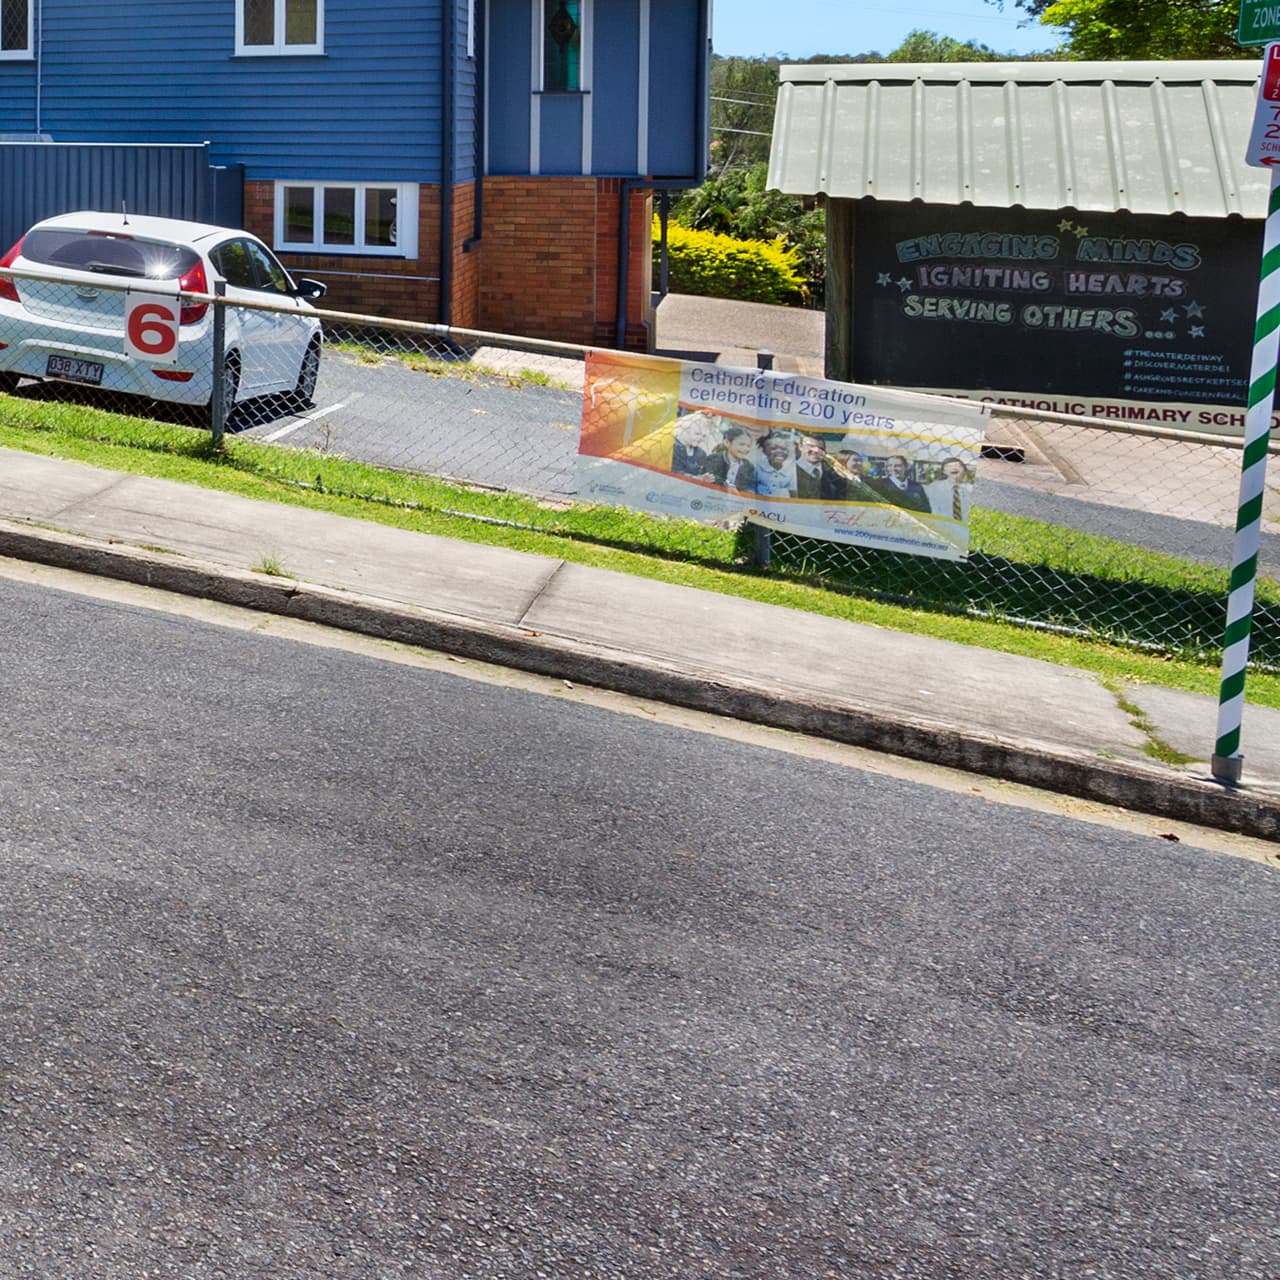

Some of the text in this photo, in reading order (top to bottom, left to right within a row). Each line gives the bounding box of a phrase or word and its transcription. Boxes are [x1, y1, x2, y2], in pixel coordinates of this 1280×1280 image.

[896, 232, 1202, 271] ENGAGING MINDS
[918, 266, 1186, 297] IGNITING HEARTS
[903, 295, 1012, 323] SERVING
[128, 303, 176, 355] 6
[691, 368, 867, 407] Catholic Education
[690, 387, 896, 430] celebrating 200 years
[1091, 404, 1192, 424] PRIMARY
[1198, 411, 1280, 430] SCHO
[757, 511, 787, 523] ACU
